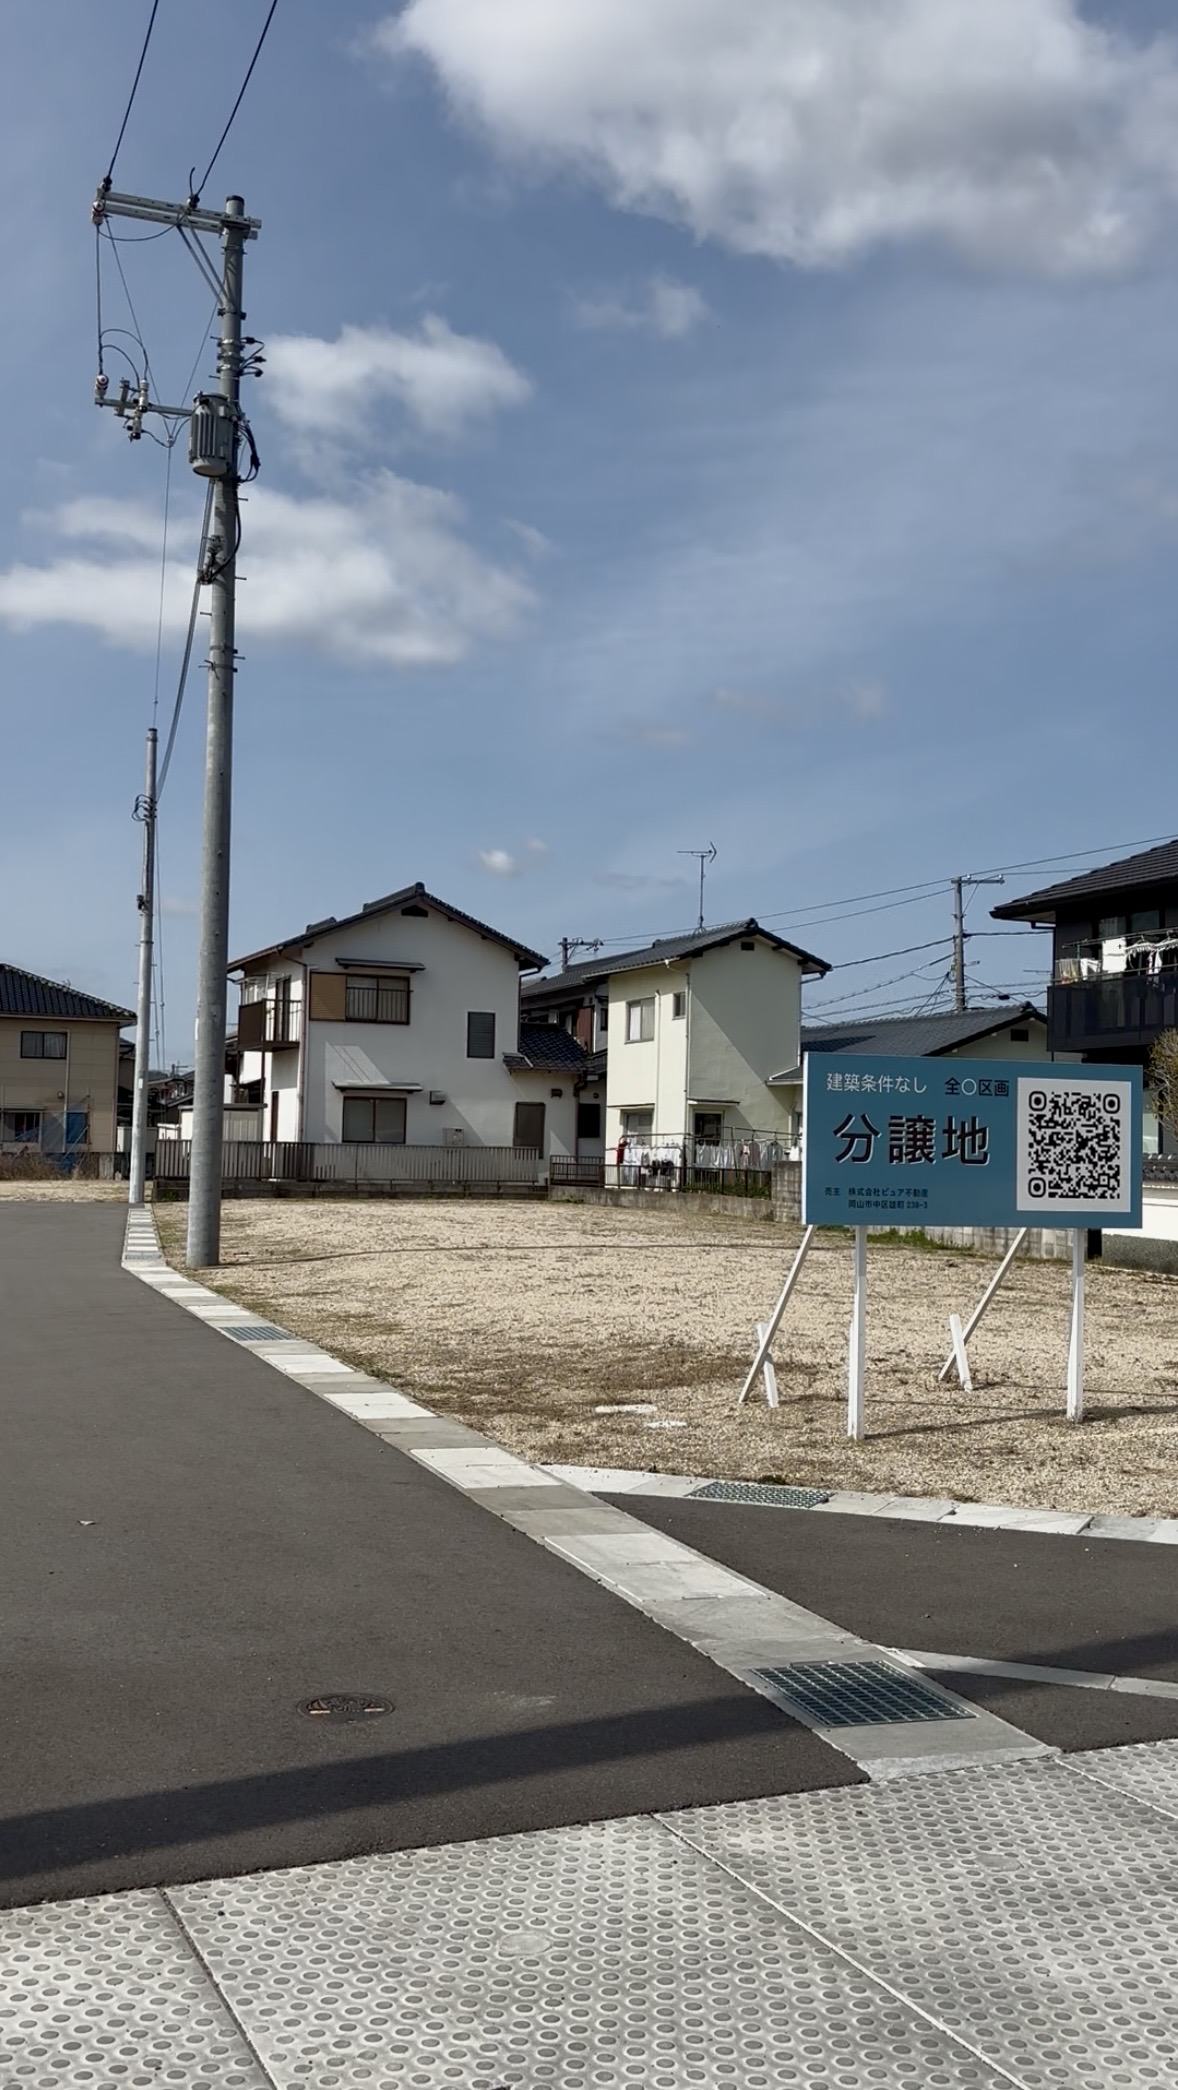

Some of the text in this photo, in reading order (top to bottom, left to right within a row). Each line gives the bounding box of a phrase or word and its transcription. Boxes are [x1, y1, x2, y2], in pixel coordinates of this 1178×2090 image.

[826, 1072, 927, 1094] 建築条件なし
[833, 1112, 991, 1167] 分譲地
[824, 1186, 841, 1197] 売主
